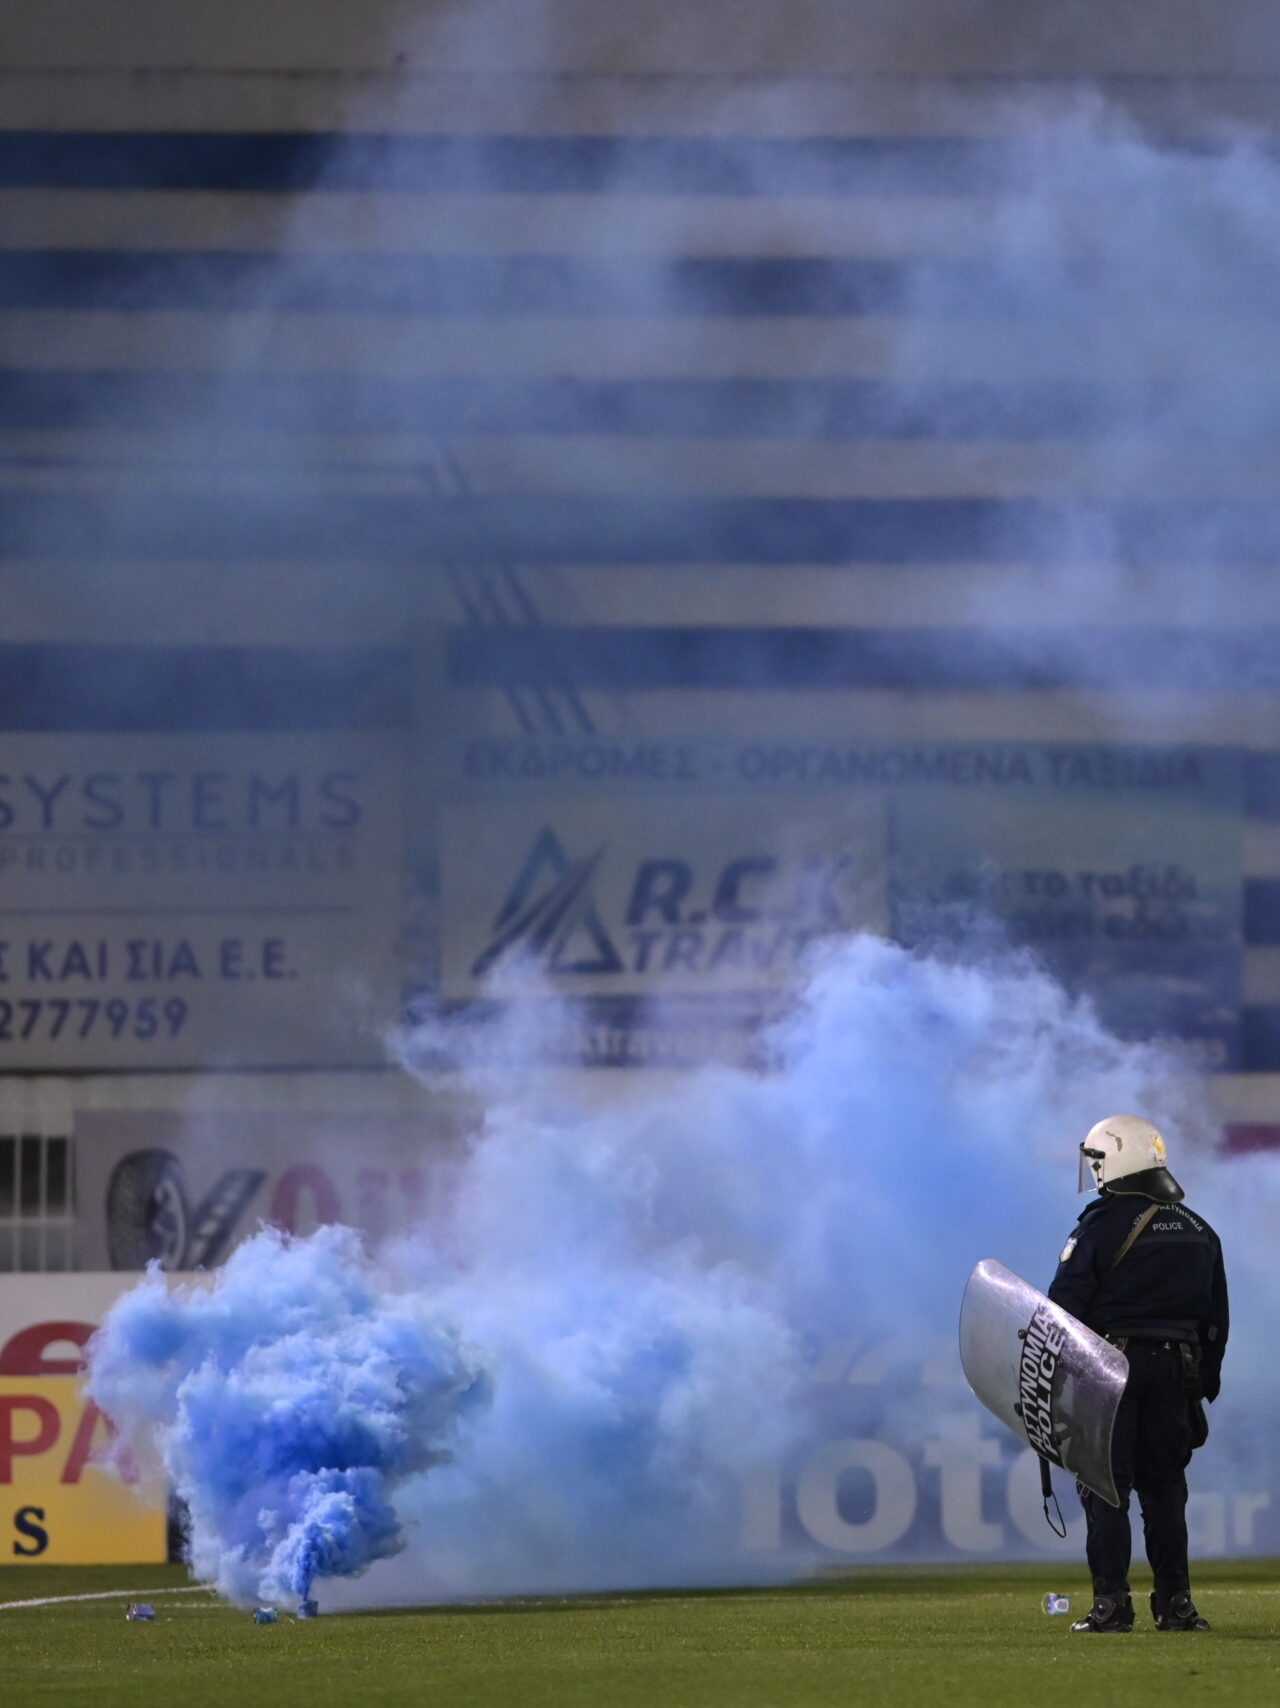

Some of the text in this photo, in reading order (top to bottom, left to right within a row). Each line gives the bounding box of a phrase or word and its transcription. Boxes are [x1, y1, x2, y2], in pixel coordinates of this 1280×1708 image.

[26, 938, 109, 983] ΚΑΙ
[125, 938, 204, 982] ΣΙΑ
[631, 930, 815, 976] TRAV
[0, 995, 189, 1040] 2777959
[1152, 1222, 1184, 1232] POLICE
[1020, 1312, 1051, 1453] ΑΣΤΥΝΟΜΙΑ
[1038, 1328, 1066, 1457] POLICE
